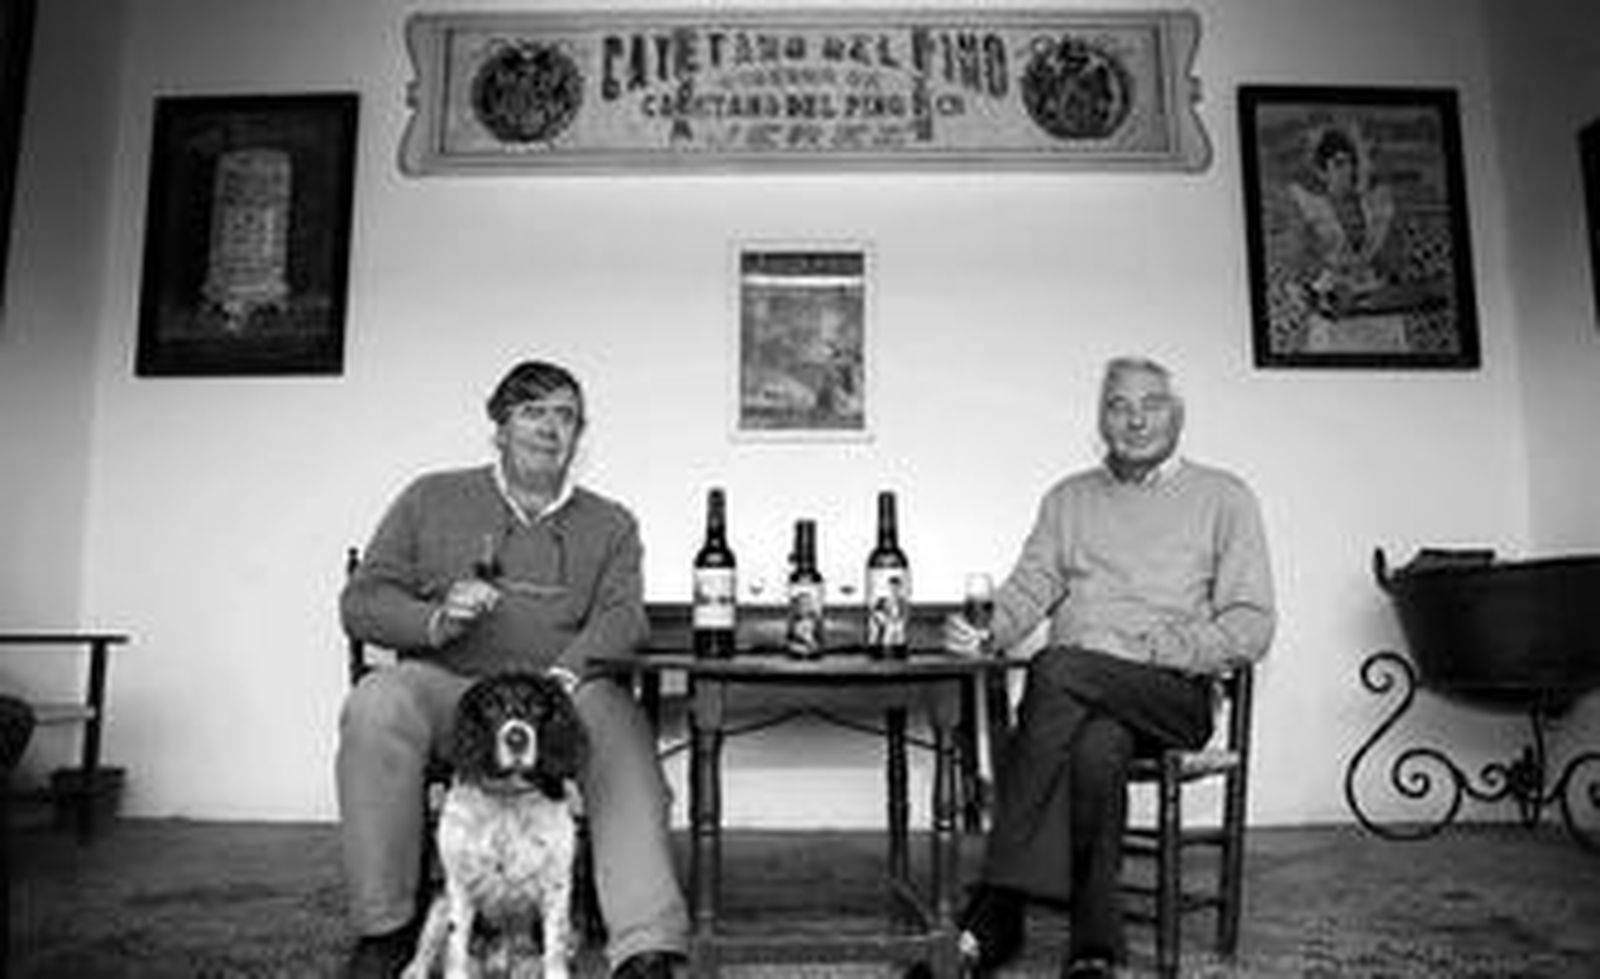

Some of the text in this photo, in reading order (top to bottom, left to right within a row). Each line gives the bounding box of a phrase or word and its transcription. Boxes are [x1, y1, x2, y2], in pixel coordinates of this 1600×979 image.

[602, 28, 1009, 101] CAYETANO DEL PINO
[786, 94, 837, 118] DEL
